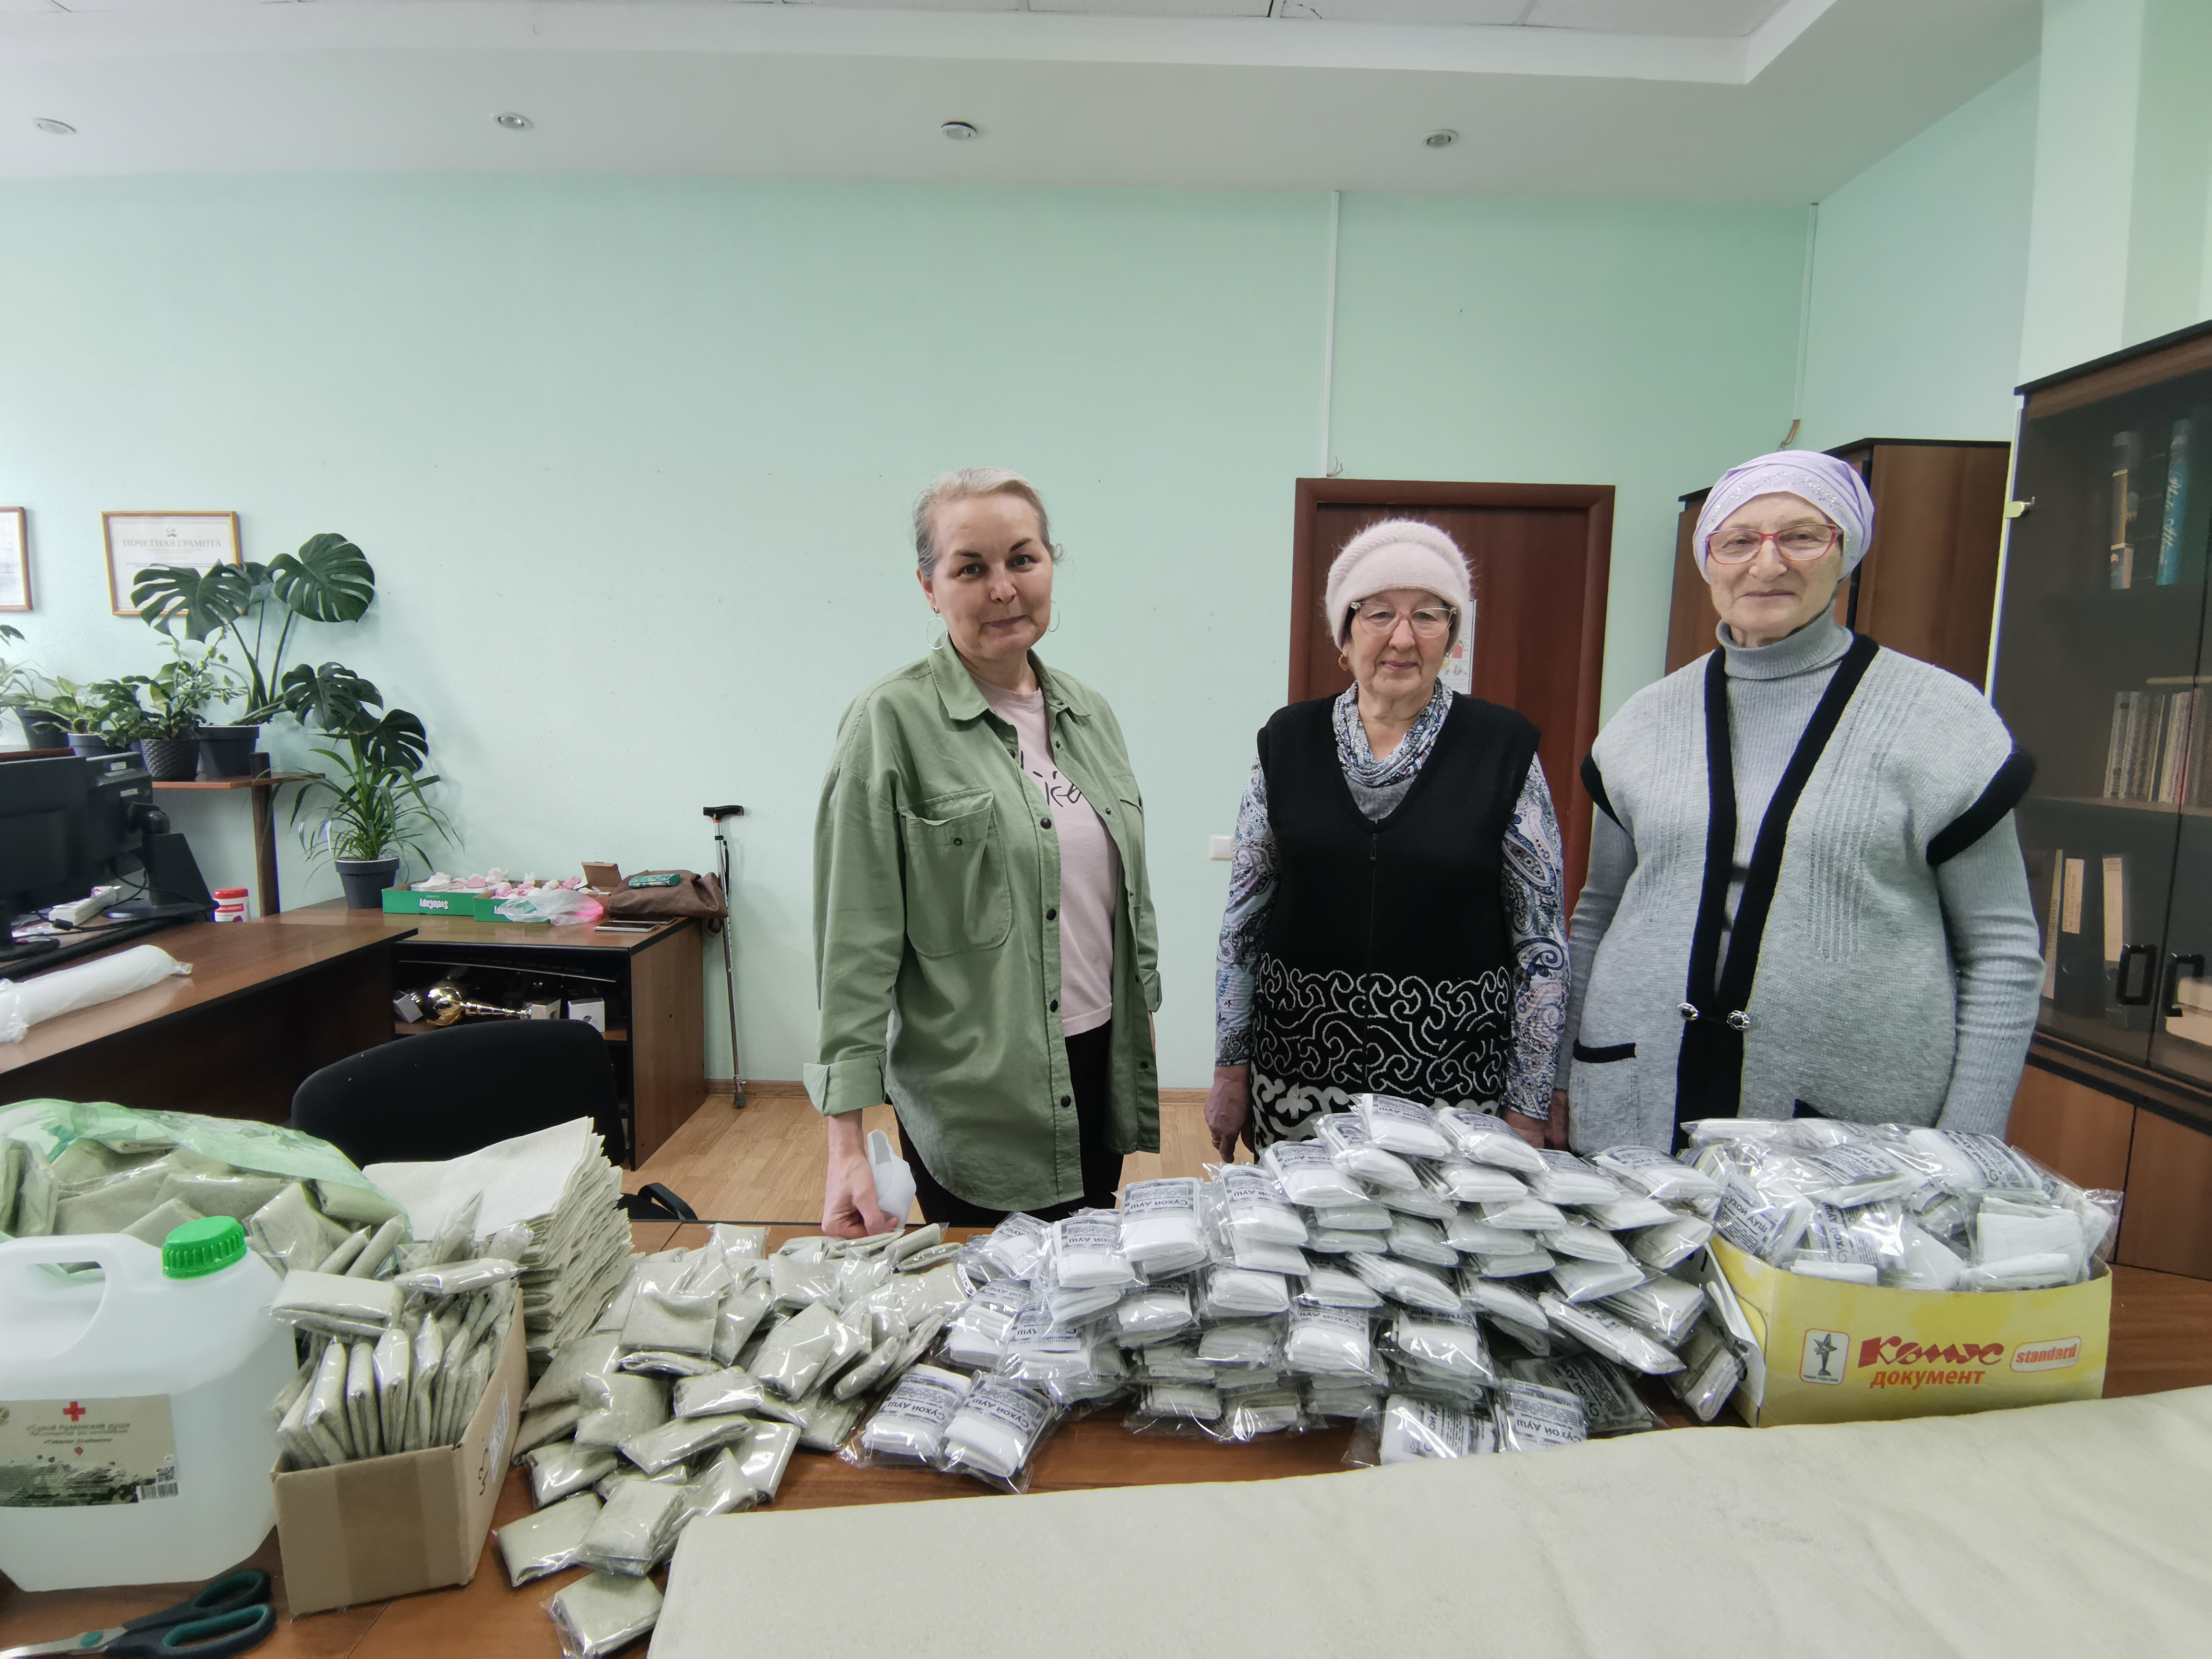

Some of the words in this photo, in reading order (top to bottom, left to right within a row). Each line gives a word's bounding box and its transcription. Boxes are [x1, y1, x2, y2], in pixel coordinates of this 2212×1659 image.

[123, 539, 175, 547] ПОЧЕТНАЯ
[177, 539, 222, 547] ГРАМОТА
[420, 898, 448, 910] SvetoCopy
[1858, 1336, 2005, 1369] Комус
[2015, 1342, 2078, 1364] standard
[1869, 1370, 1986, 1390] документ
